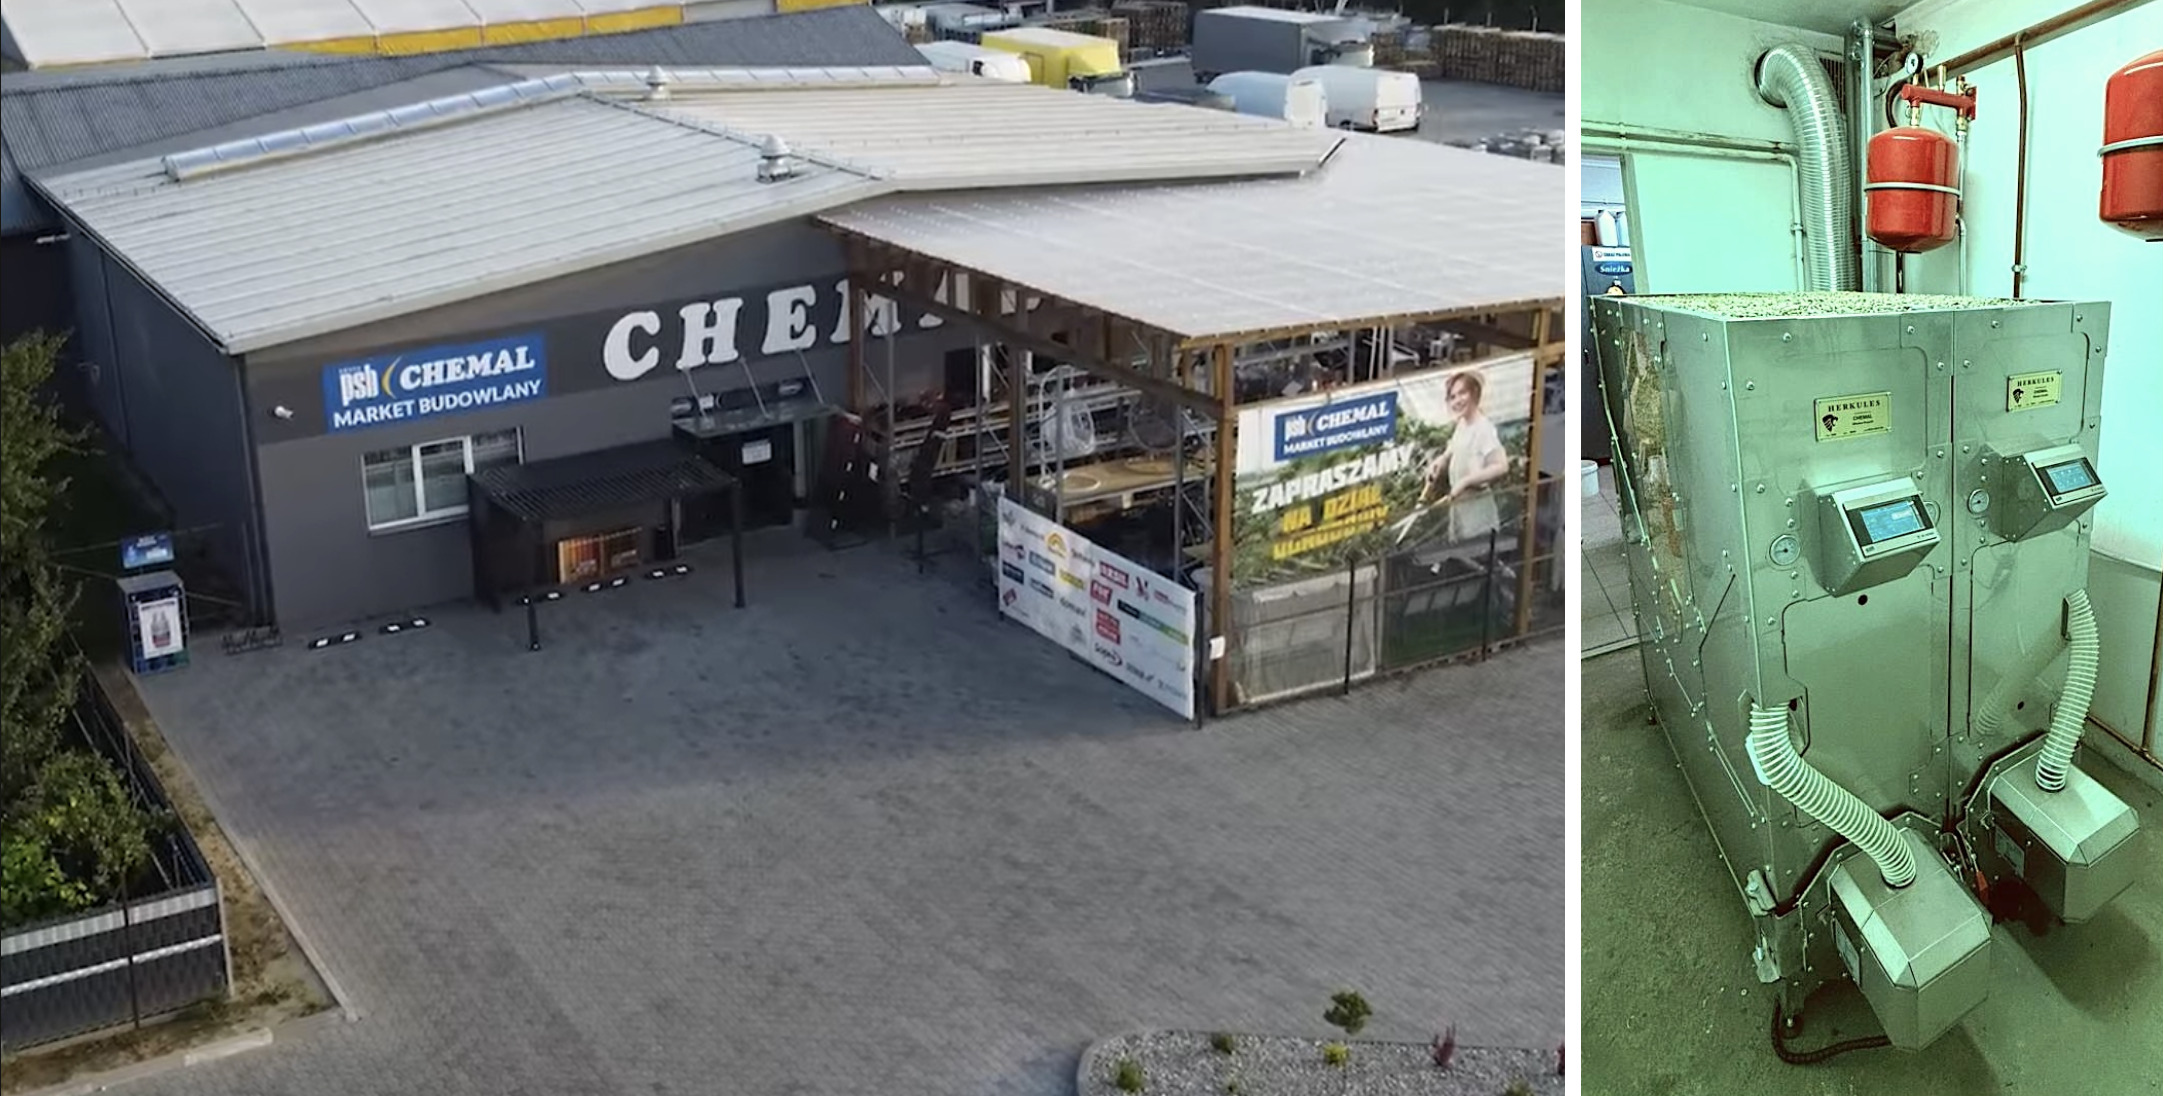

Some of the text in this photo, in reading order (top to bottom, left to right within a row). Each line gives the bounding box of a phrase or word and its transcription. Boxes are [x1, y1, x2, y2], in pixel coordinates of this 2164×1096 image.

[340, 346, 535, 407] psb CHEMAL
[333, 379, 542, 429] MARKET BUDOWLANY
[1316, 401, 1390, 432] CHEMAL
[1828, 399, 1881, 412] HERKULES
[1283, 424, 1390, 456] MARKET BUDOWLANY
[1251, 442, 1418, 515] ZAPRASZAMY
